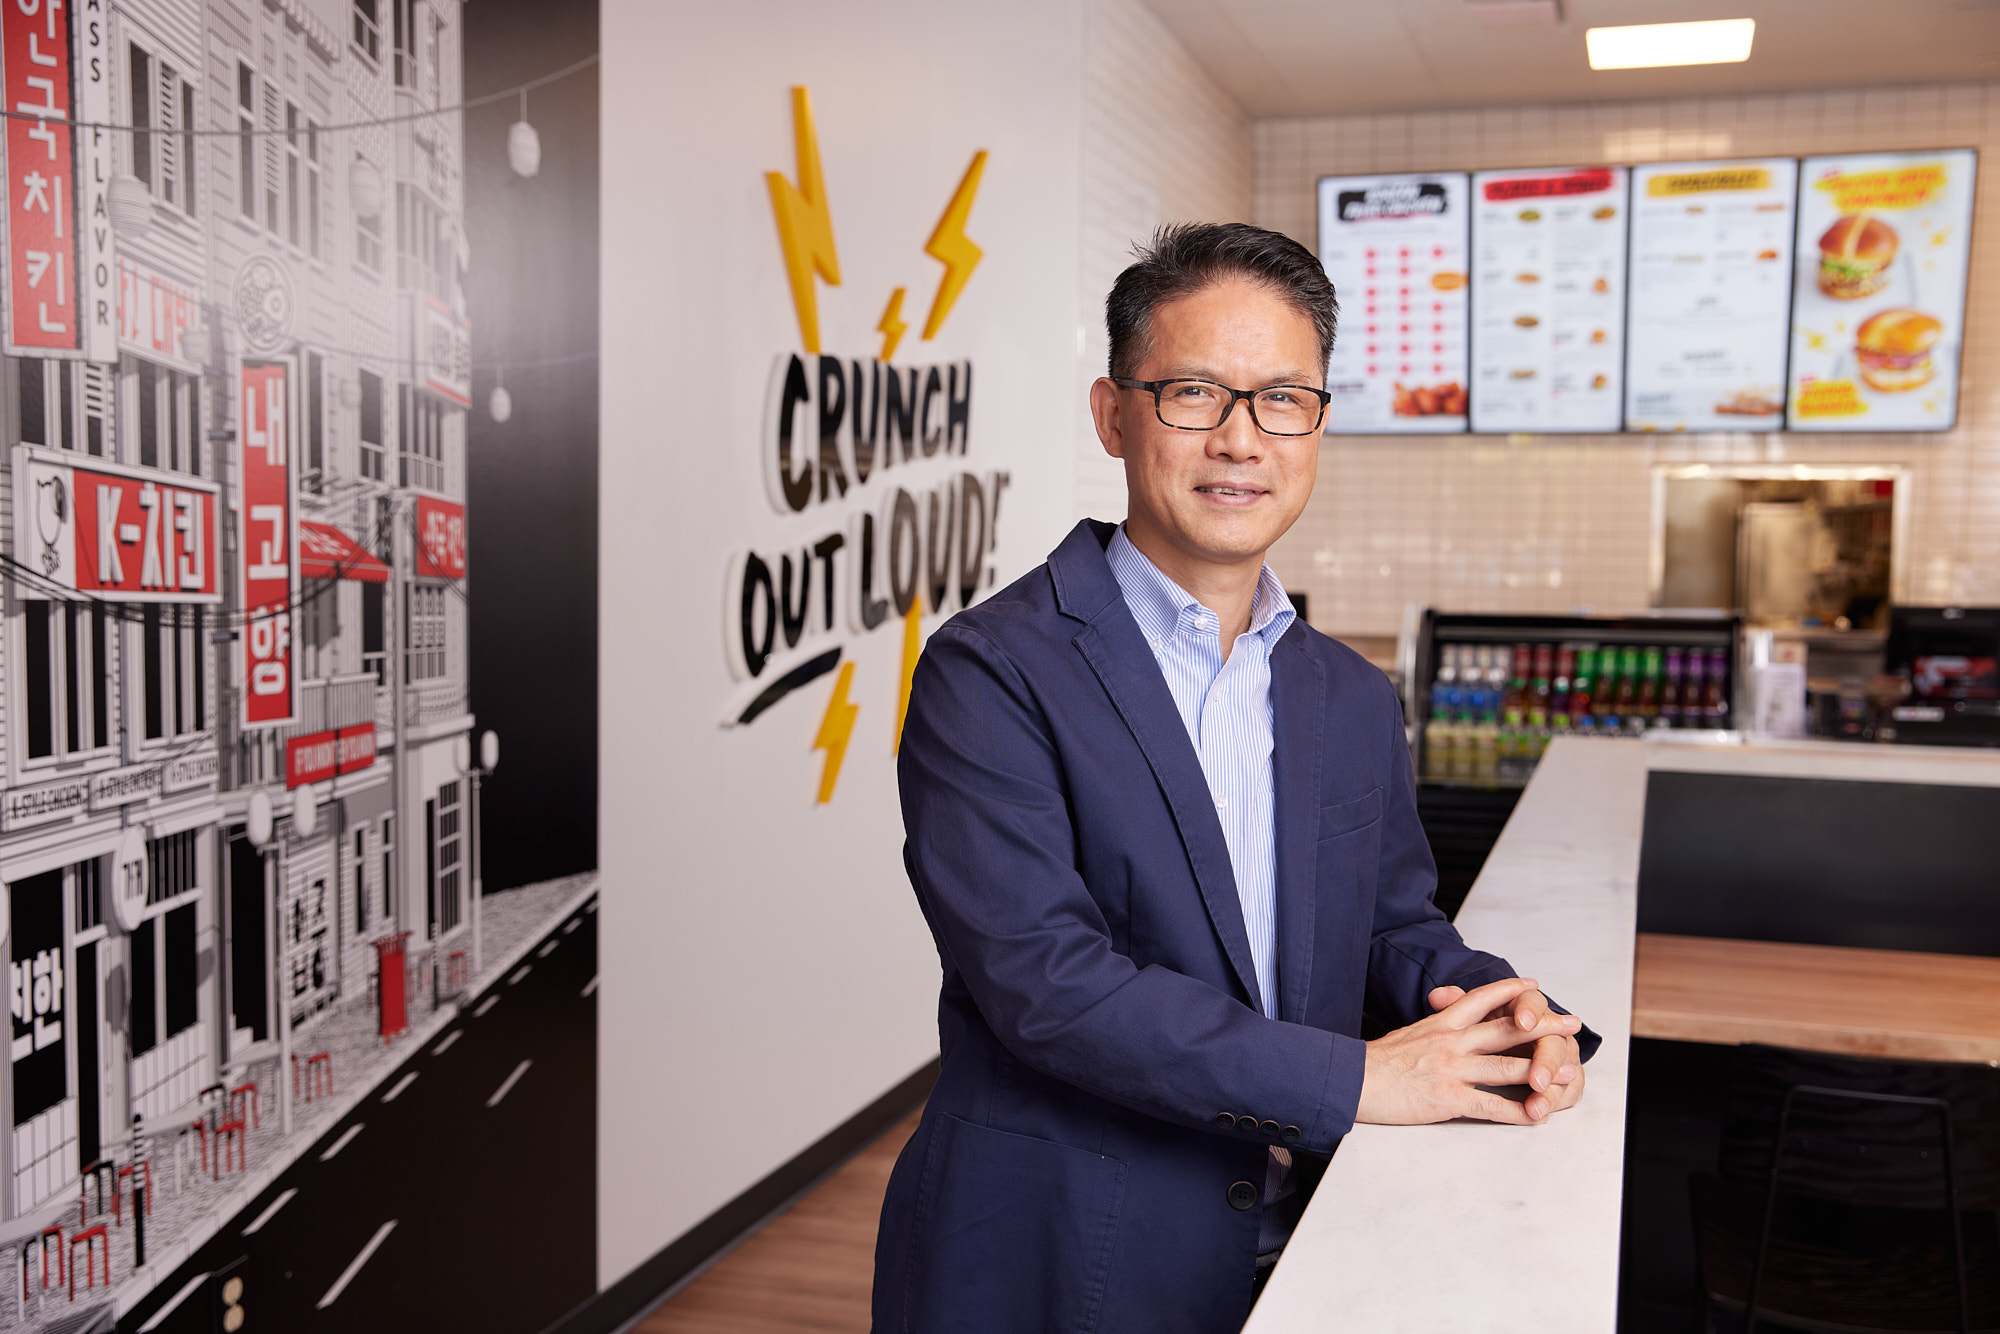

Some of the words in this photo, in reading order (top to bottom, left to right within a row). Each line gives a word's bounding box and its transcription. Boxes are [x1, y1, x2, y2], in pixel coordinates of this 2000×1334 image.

[93, 124, 109, 326] FLAVOR
[779, 353, 972, 513] CRUNCH
[97, 481, 205, 590] K-치킨
[247, 376, 291, 697] 내고향
[741, 531, 845, 678] OUT
[861, 471, 1010, 631] LOUD!
